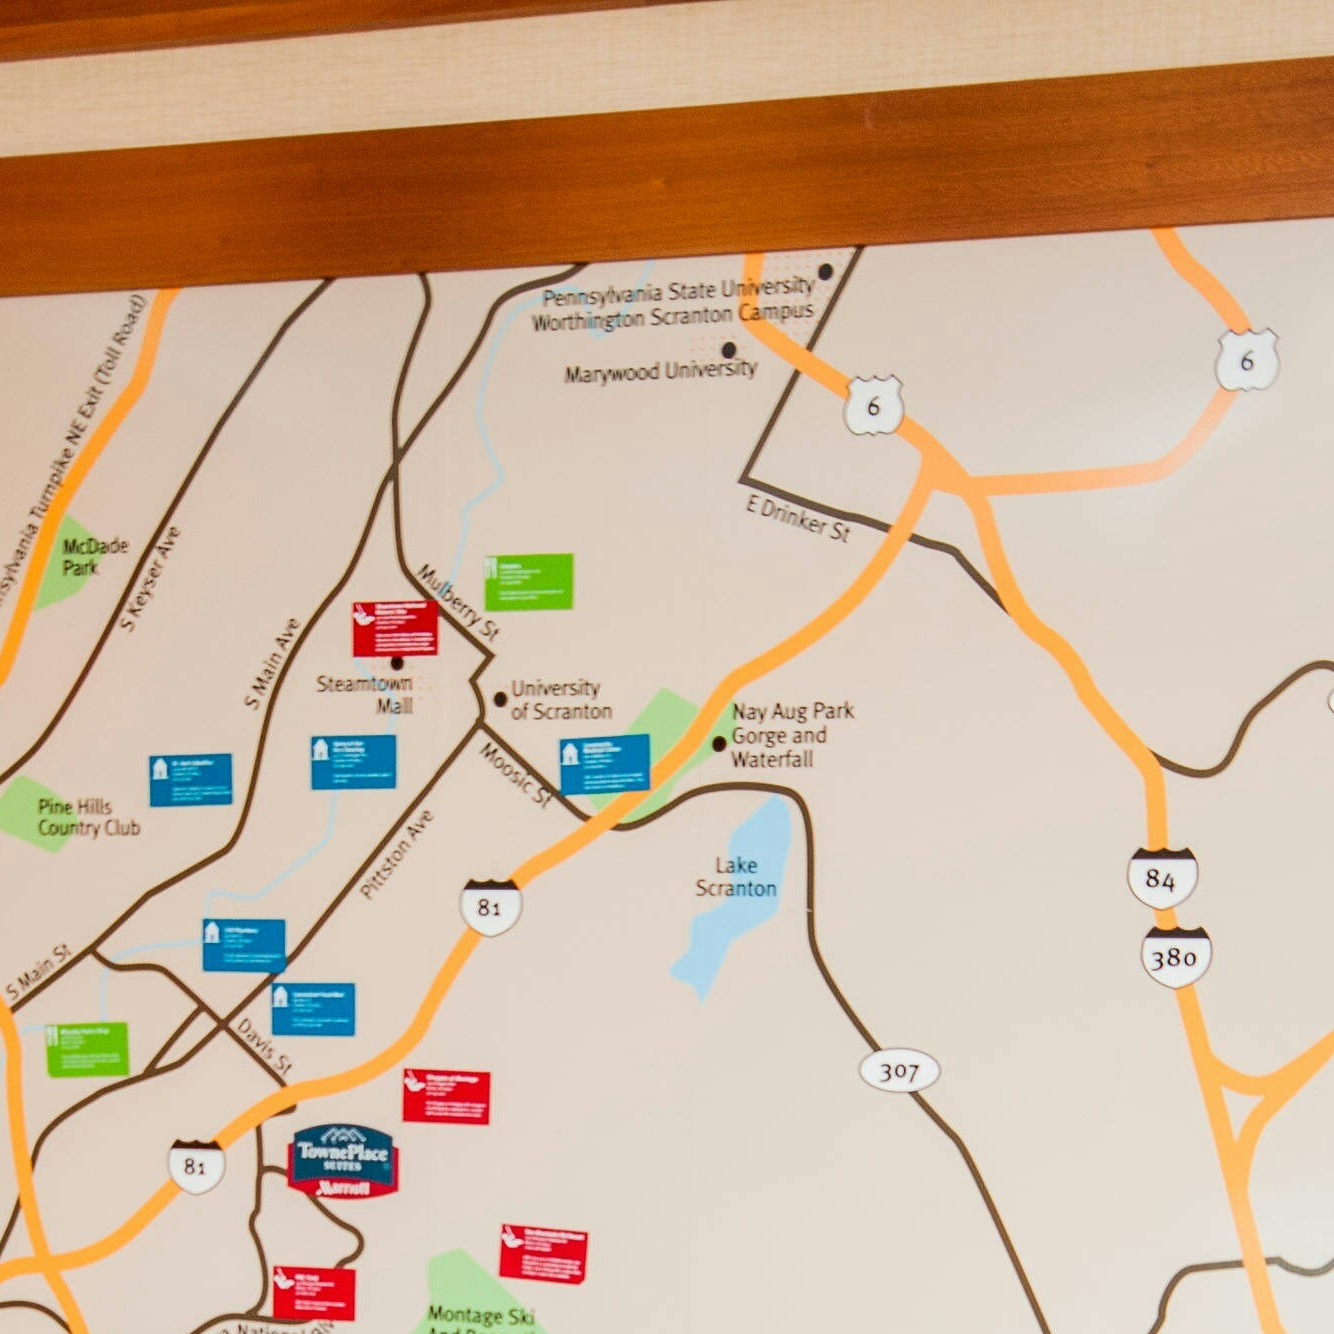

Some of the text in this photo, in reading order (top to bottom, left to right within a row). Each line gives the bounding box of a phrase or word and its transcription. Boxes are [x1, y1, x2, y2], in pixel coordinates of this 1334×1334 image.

[542, 277, 816, 308] Pennsylvania State University
[532, 304, 815, 333] Worthington Scranton Campus
[564, 358, 759, 385] Marywood University
[1239, 350, 1255, 372] 6
[28, 447, 76, 520] Turnpike
[65, 417, 88, 444] NE
[77, 385, 103, 419] Exit
[94, 348, 121, 384] (Toll
[112, 294, 148, 344] Road)
[868, 396, 881, 416] 6
[746, 495, 850, 543] E Drinker St
[63, 537, 128, 555] McDade
[63, 559, 99, 576] Park
[119, 526, 181, 633] S Keyser Ave
[417, 562, 481, 628] Mulberry
[478, 618, 500, 643] St
[245, 618, 300, 711] S Main Ave
[316, 676, 413, 693] Steamtown
[511, 679, 601, 699] University
[376, 697, 413, 715] Mall
[510, 702, 613, 721] of Scranton
[732, 702, 855, 724] Nay Aug Park
[732, 726, 827, 747] Gorge and
[731, 749, 814, 769] Waterfall
[479, 741, 538, 799] Moosic
[529, 785, 555, 811] St
[38, 799, 113, 815] Pine Hills
[38, 819, 141, 840] Country Club
[359, 809, 435, 900] Pittston Ave
[716, 857, 759, 875] Lake
[696, 879, 777, 898] Scranton
[1145, 869, 1176, 892] 84
[478, 898, 501, 918] 81
[1151, 947, 1197, 972] 380
[5, 942, 73, 1001] S Main St
[238, 1017, 294, 1076] Davis St
[879, 1061, 921, 1084] 307
[297, 1141, 389, 1162] TownePlace
[183, 1158, 206, 1175] 81
[427, 1306, 536, 1327] Montage Ski
